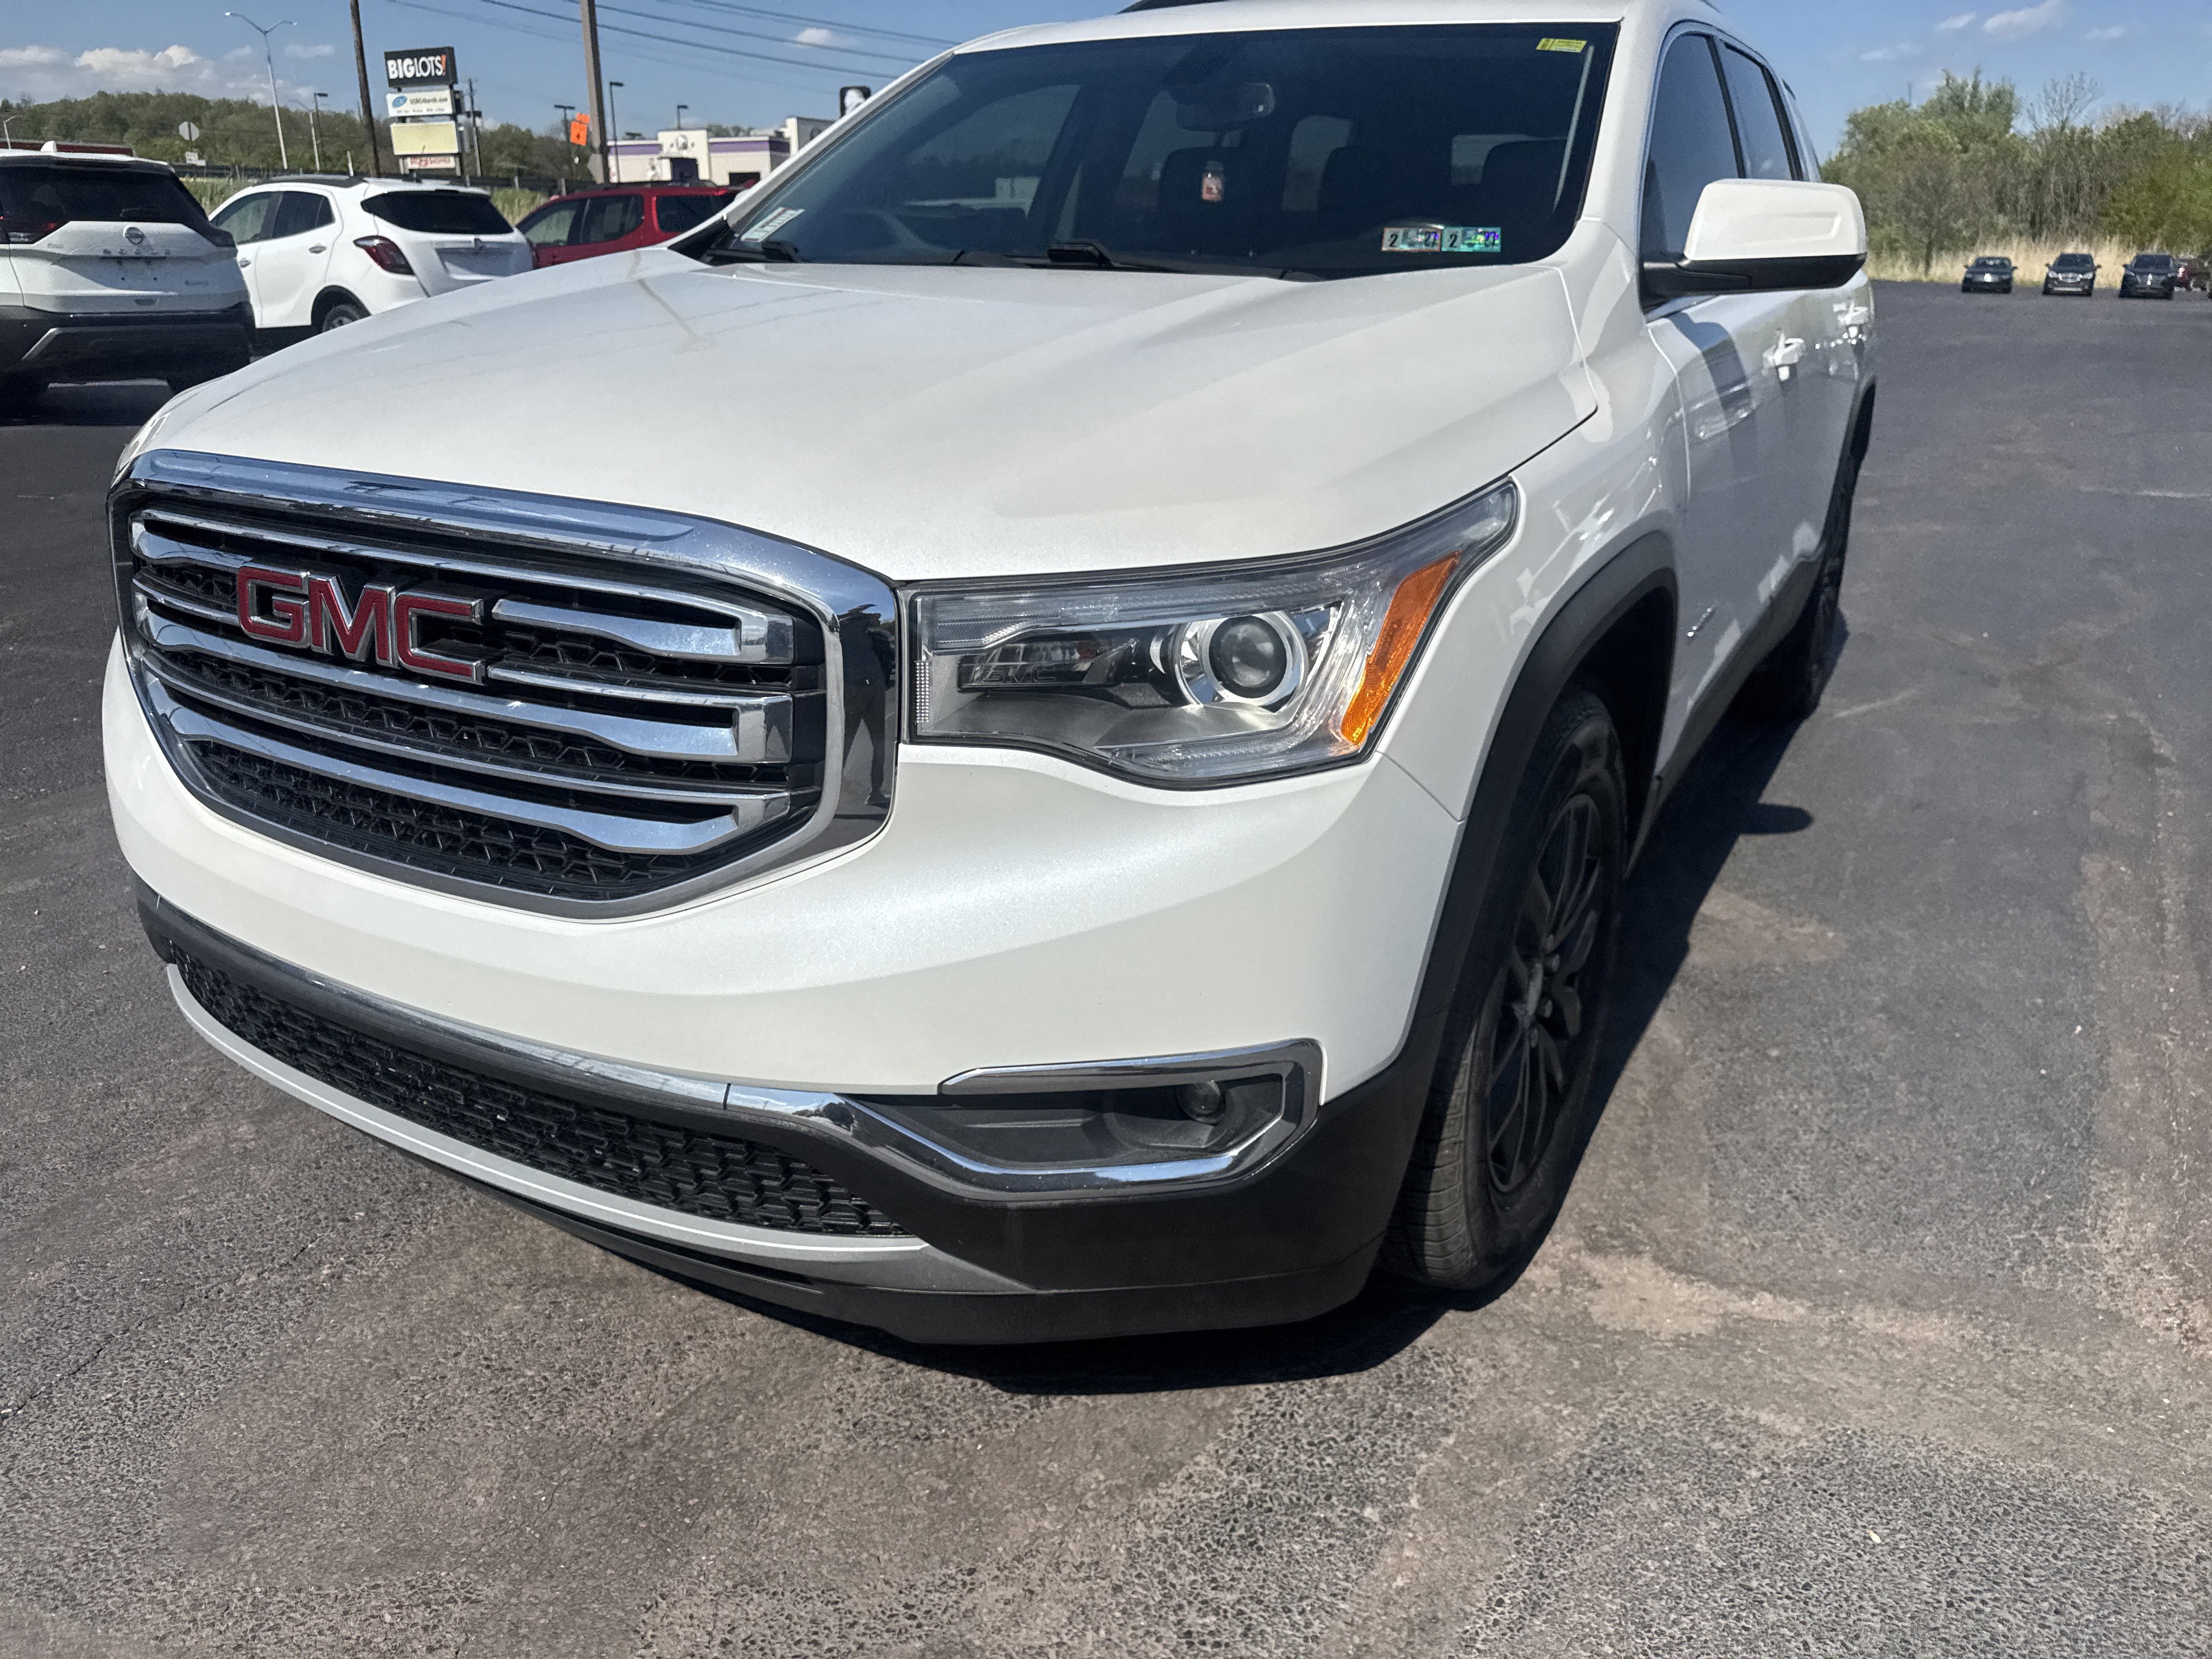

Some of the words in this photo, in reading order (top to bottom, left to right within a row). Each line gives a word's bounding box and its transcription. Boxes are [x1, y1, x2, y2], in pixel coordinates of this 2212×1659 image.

[1390, 233, 1398, 247] 2
[1449, 234, 1458, 248] 2
[238, 566, 485, 685] GMC
[982, 665, 1056, 684] GMC
